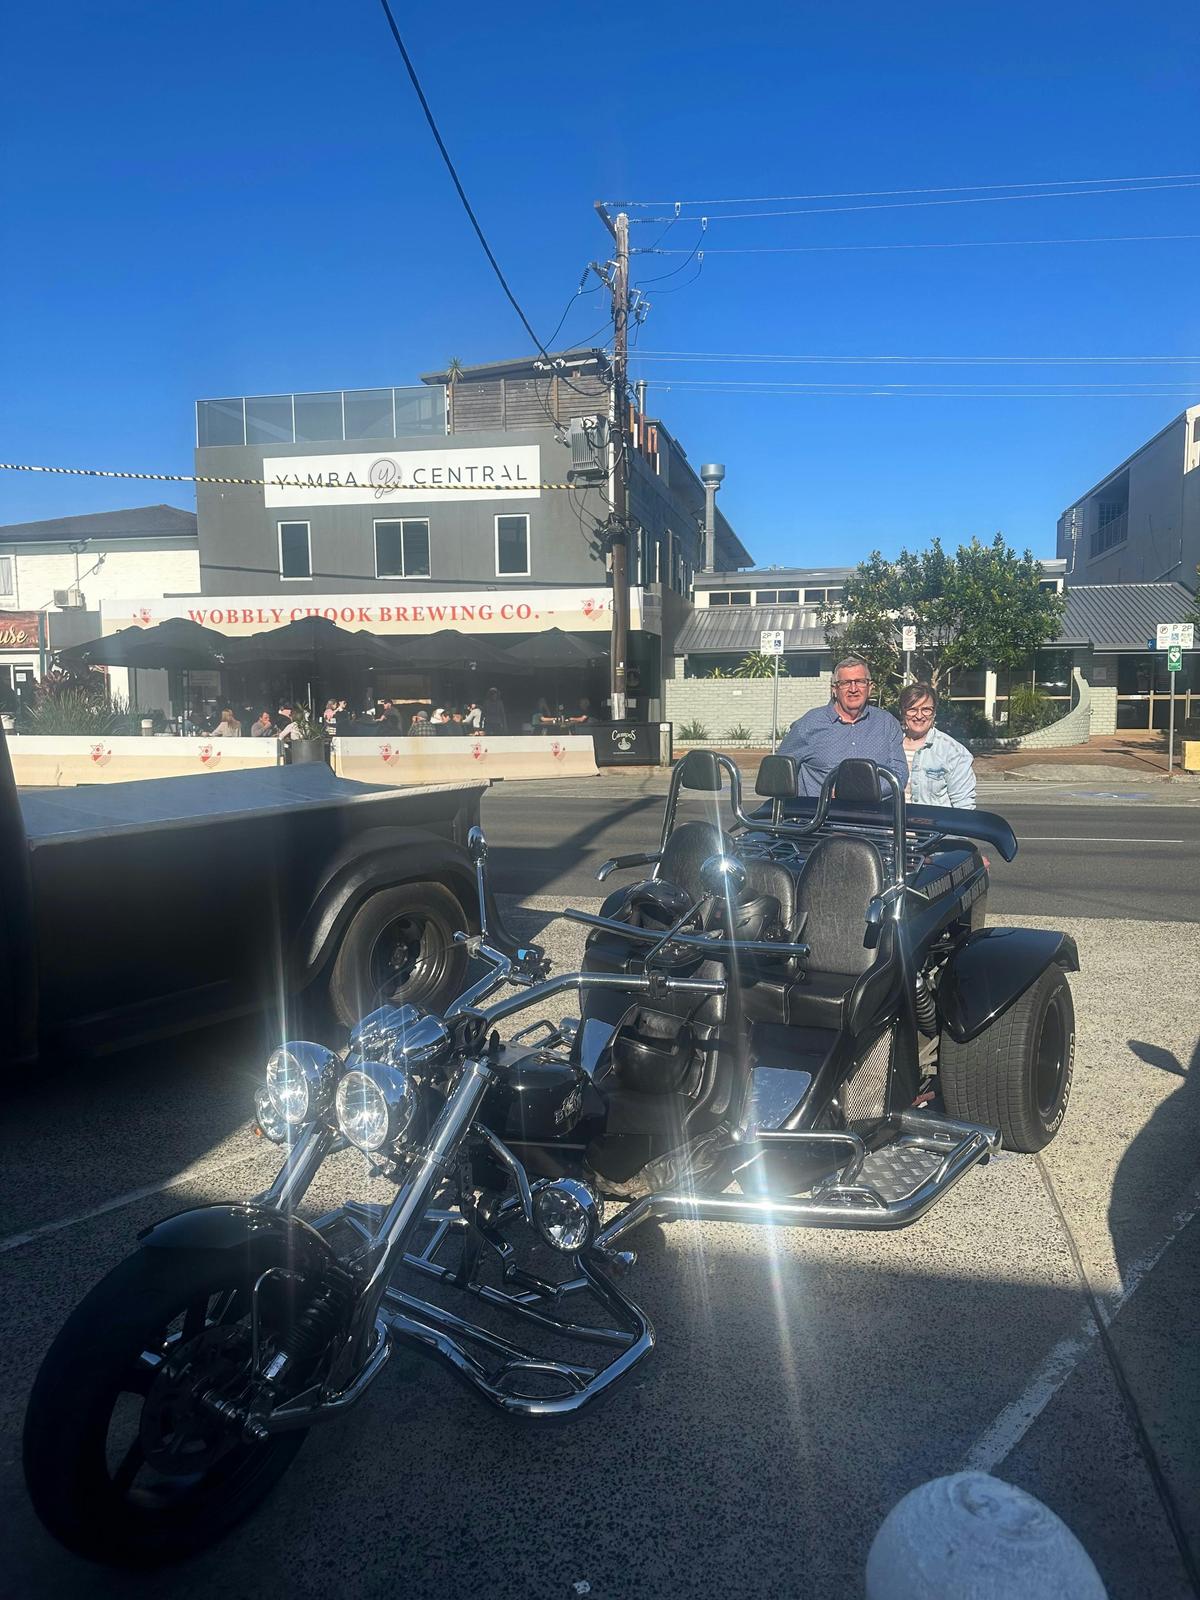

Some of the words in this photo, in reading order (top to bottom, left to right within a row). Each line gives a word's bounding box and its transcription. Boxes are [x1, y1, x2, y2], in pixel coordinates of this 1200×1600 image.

[275, 472, 357, 489] YAMBA
[413, 464, 527, 484] CENTRAL
[188, 608, 284, 624] WOBBLY
[290, 607, 372, 624] CHOOK
[380, 604, 493, 622] BREWING
[501, 603, 539, 620] CO.
[1063, 1032, 1075, 1106] COOPER
